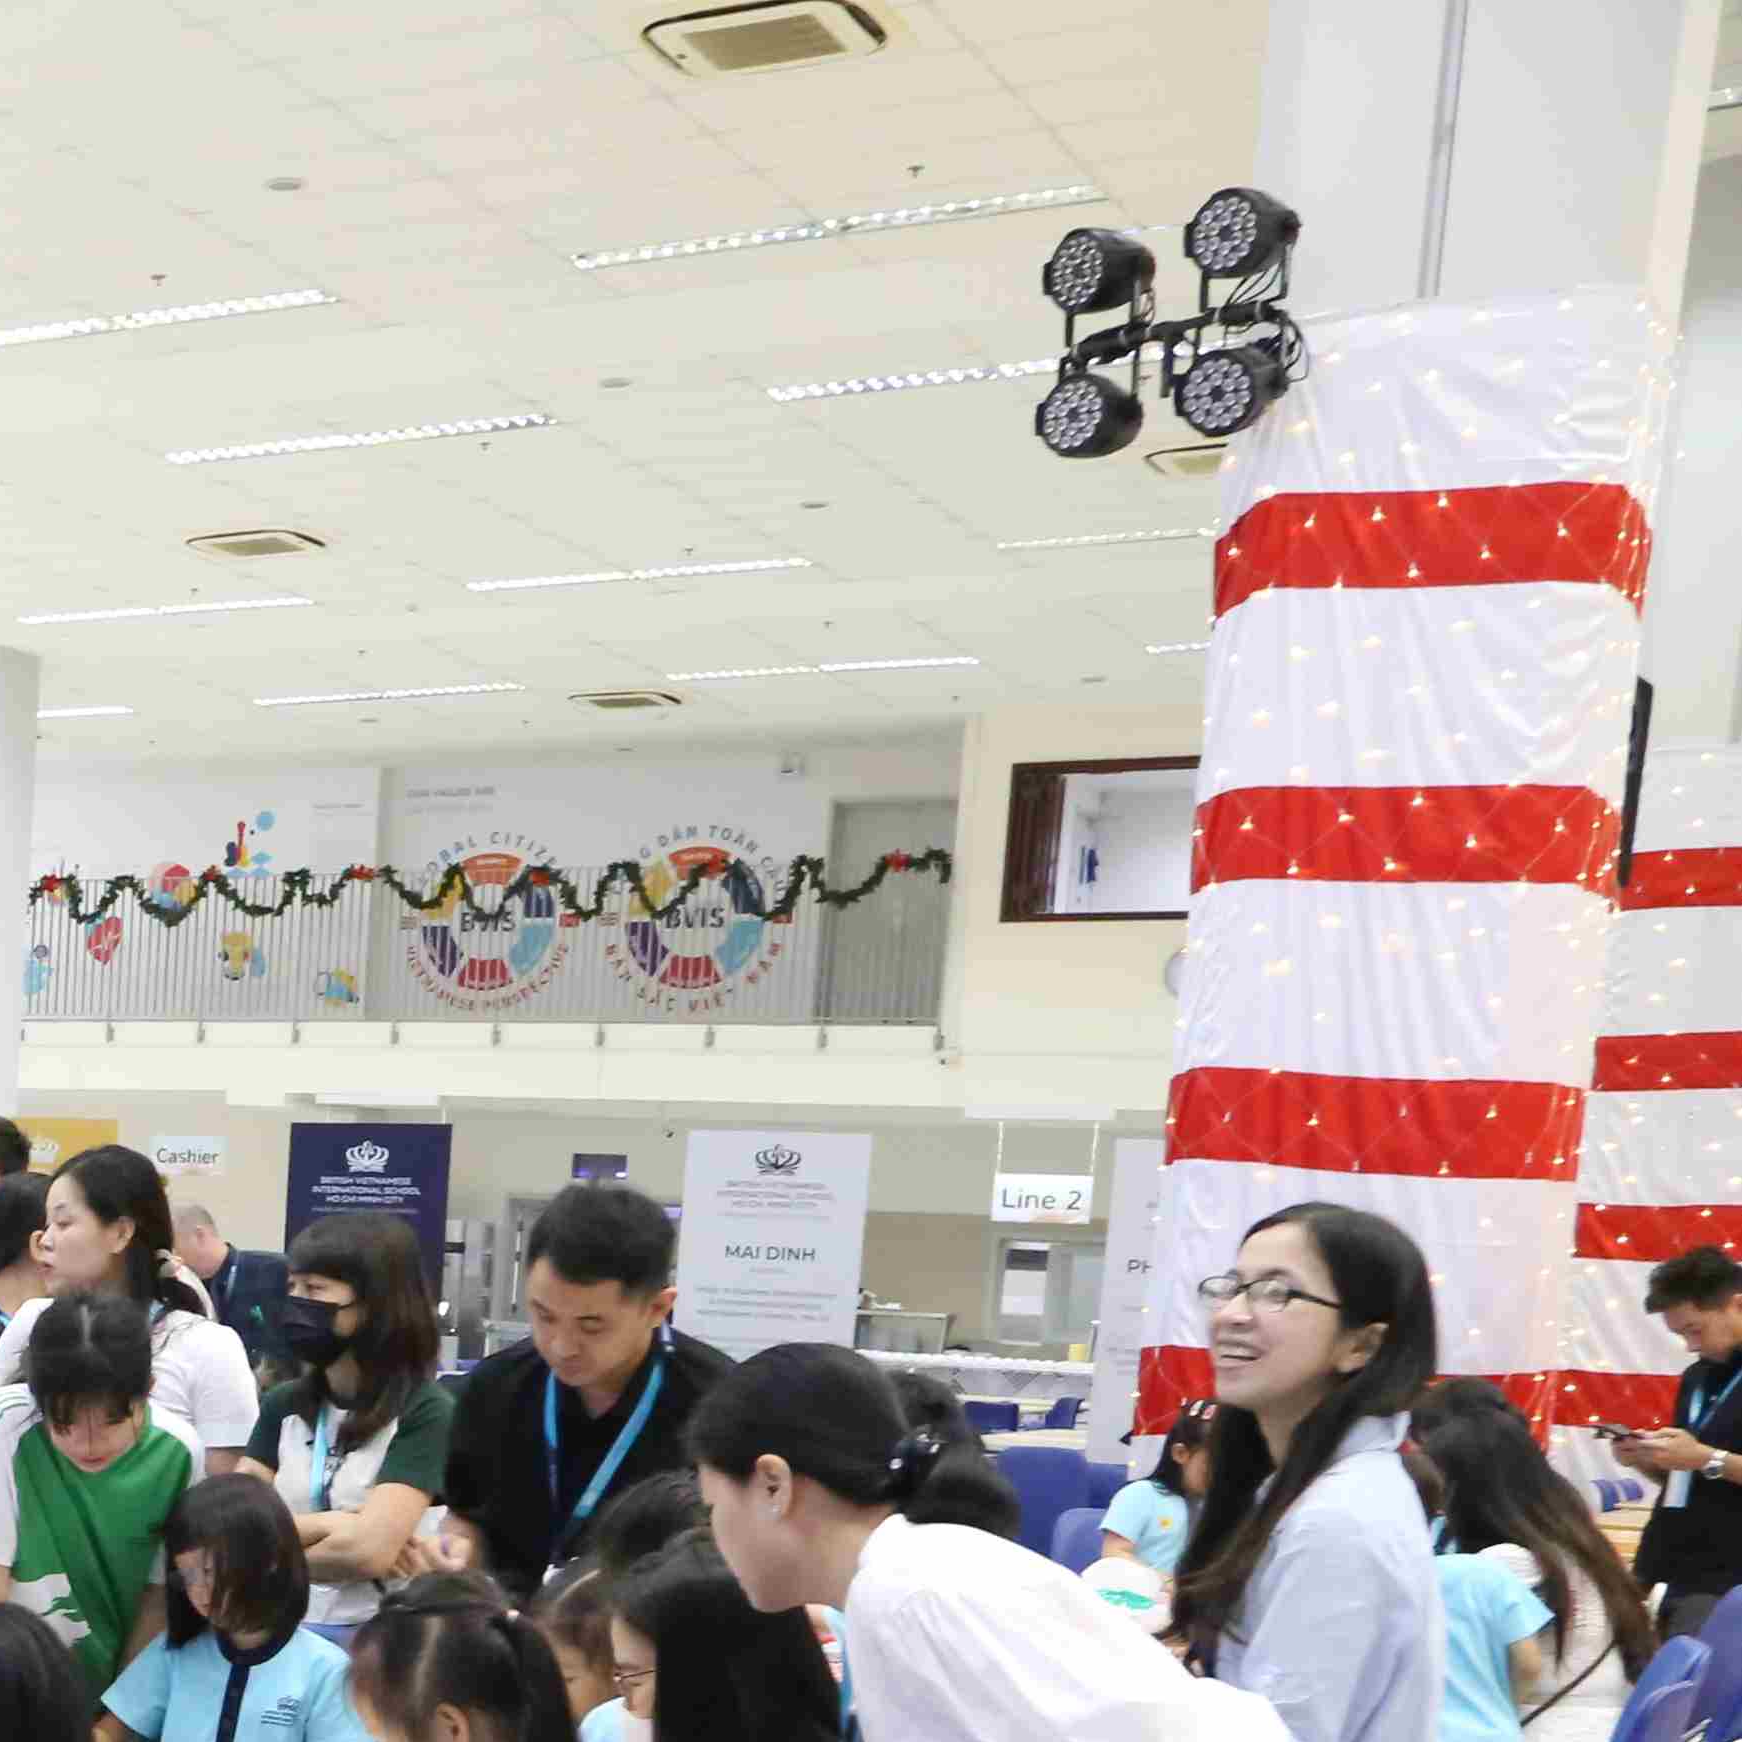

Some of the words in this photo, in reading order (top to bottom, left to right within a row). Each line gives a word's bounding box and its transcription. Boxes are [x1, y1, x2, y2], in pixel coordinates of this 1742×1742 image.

[666, 907, 725, 929] BVIS
[156, 1147, 220, 1165] Cashier
[1001, 1187, 1056, 1210] Line
[1067, 1190, 1083, 1211] 2
[725, 1244, 760, 1260] MAI
[766, 1246, 816, 1262] DINH
